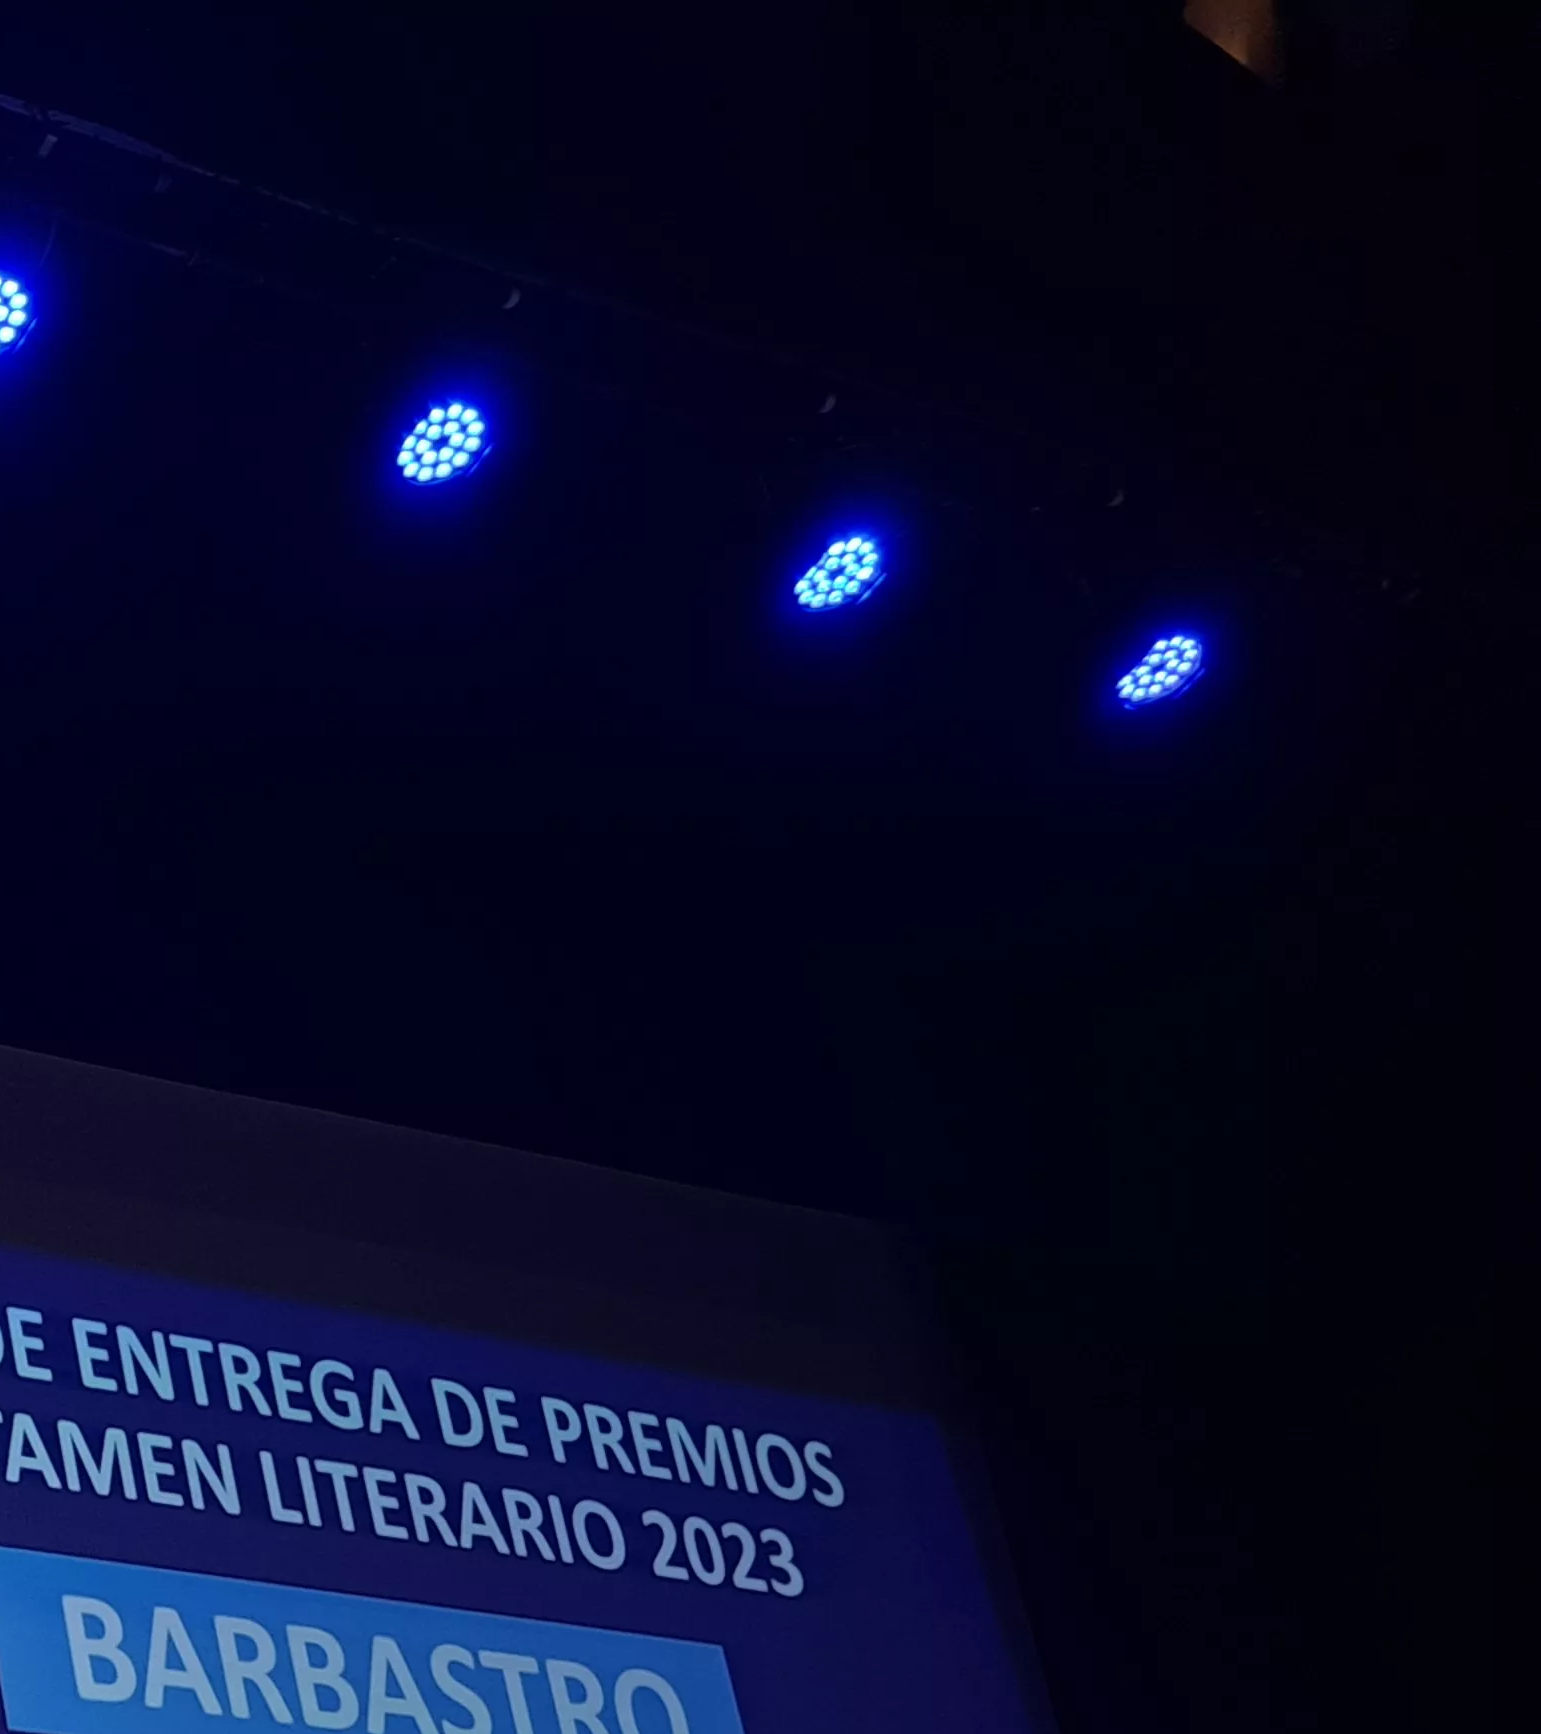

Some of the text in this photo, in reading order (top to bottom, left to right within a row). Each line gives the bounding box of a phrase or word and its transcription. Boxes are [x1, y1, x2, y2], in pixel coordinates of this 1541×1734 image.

[72, 1317, 420, 1440] ENTREGA
[431, 1378, 528, 1457] DE
[541, 1396, 844, 1507] PREMIOS
[259, 1451, 625, 1569] LITERARIO
[642, 1510, 804, 1597] 2023
